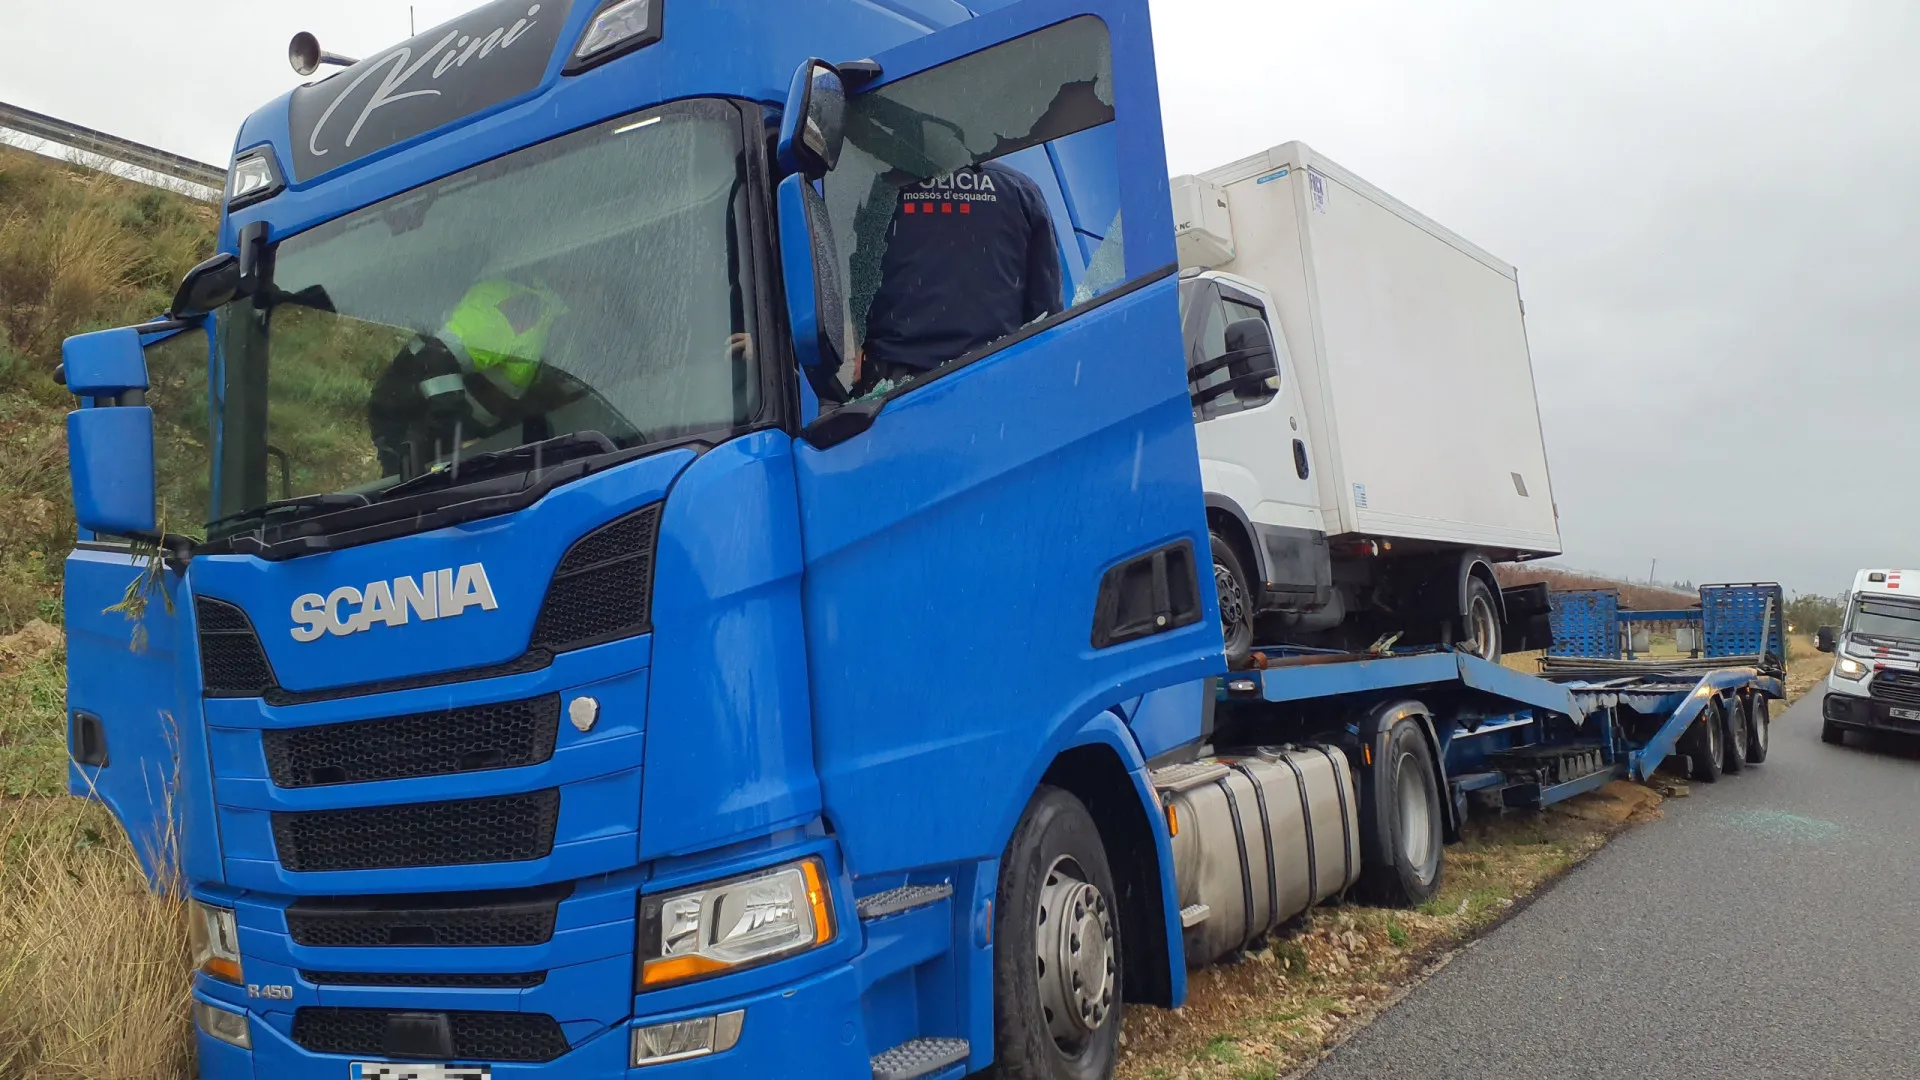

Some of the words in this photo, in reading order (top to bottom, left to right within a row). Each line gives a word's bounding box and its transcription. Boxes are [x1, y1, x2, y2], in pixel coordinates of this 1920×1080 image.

[309, 3, 541, 156] Kini
[905, 172, 995, 191] OLICIA
[903, 191, 941, 200] mossos
[943, 191, 997, 202] d'esquadra
[290, 562, 499, 642] SCANIA
[249, 984, 259, 998] R
[262, 985, 293, 1000] 450
